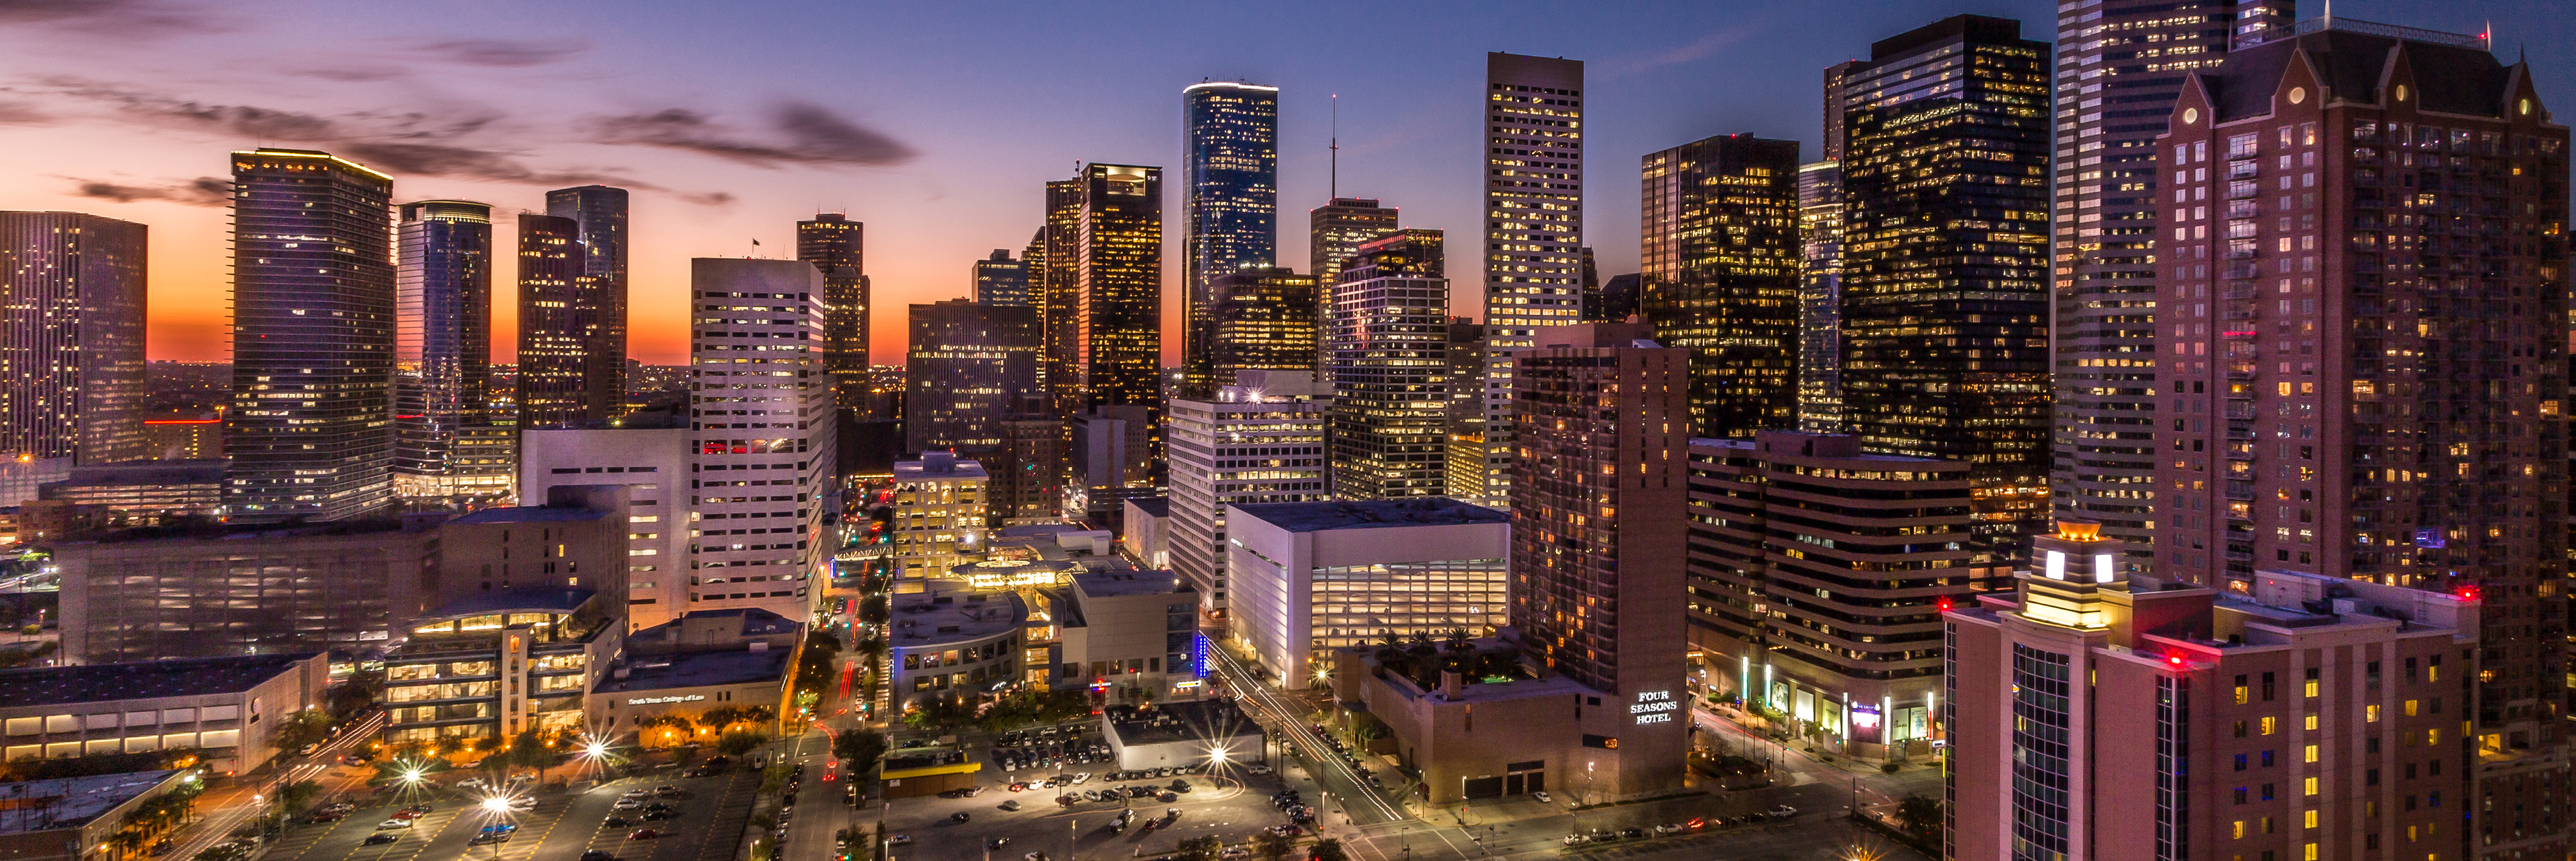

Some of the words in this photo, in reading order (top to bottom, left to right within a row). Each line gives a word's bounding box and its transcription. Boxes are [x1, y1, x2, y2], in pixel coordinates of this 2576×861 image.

[1638, 690, 1669, 702] FOUR
[1630, 701, 1677, 714] SEASONS
[1636, 713, 1671, 725] HOTEL
